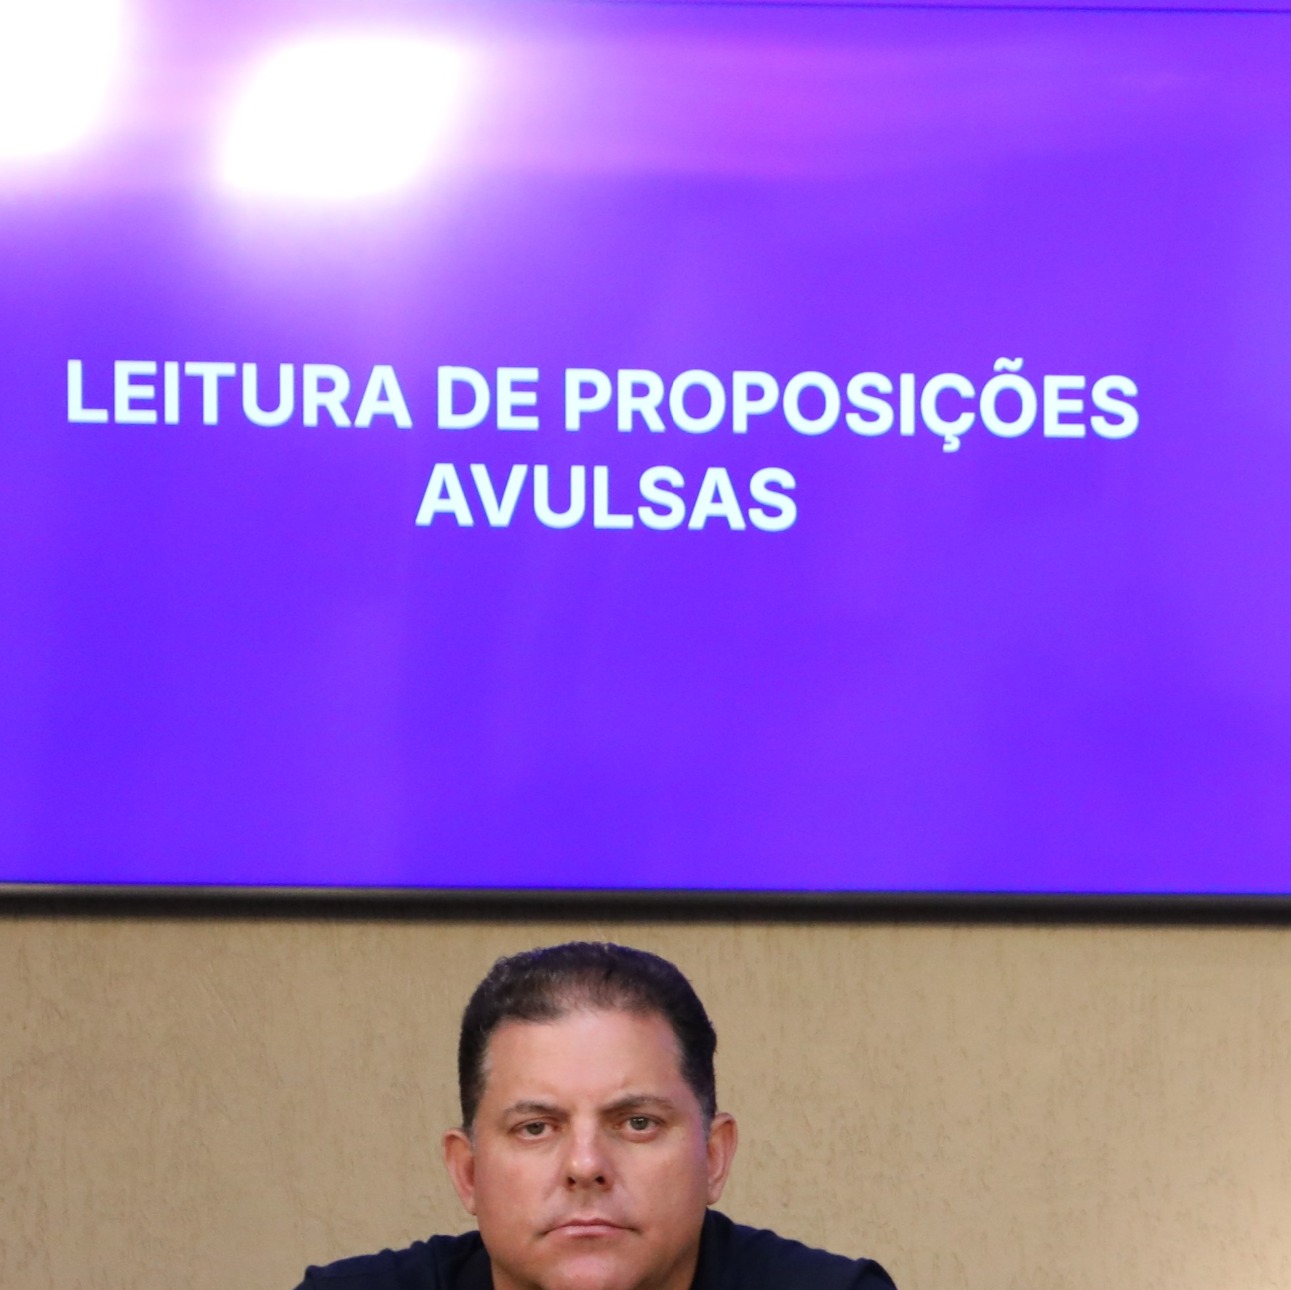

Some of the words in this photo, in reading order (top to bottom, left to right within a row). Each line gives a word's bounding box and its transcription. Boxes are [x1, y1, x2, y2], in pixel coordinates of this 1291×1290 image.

[68, 360, 412, 428] LEITURA
[438, 366, 539, 430] DE
[565, 358, 1138, 452] PROPOSIÇÕES
[416, 464, 796, 531] AVULSAS
